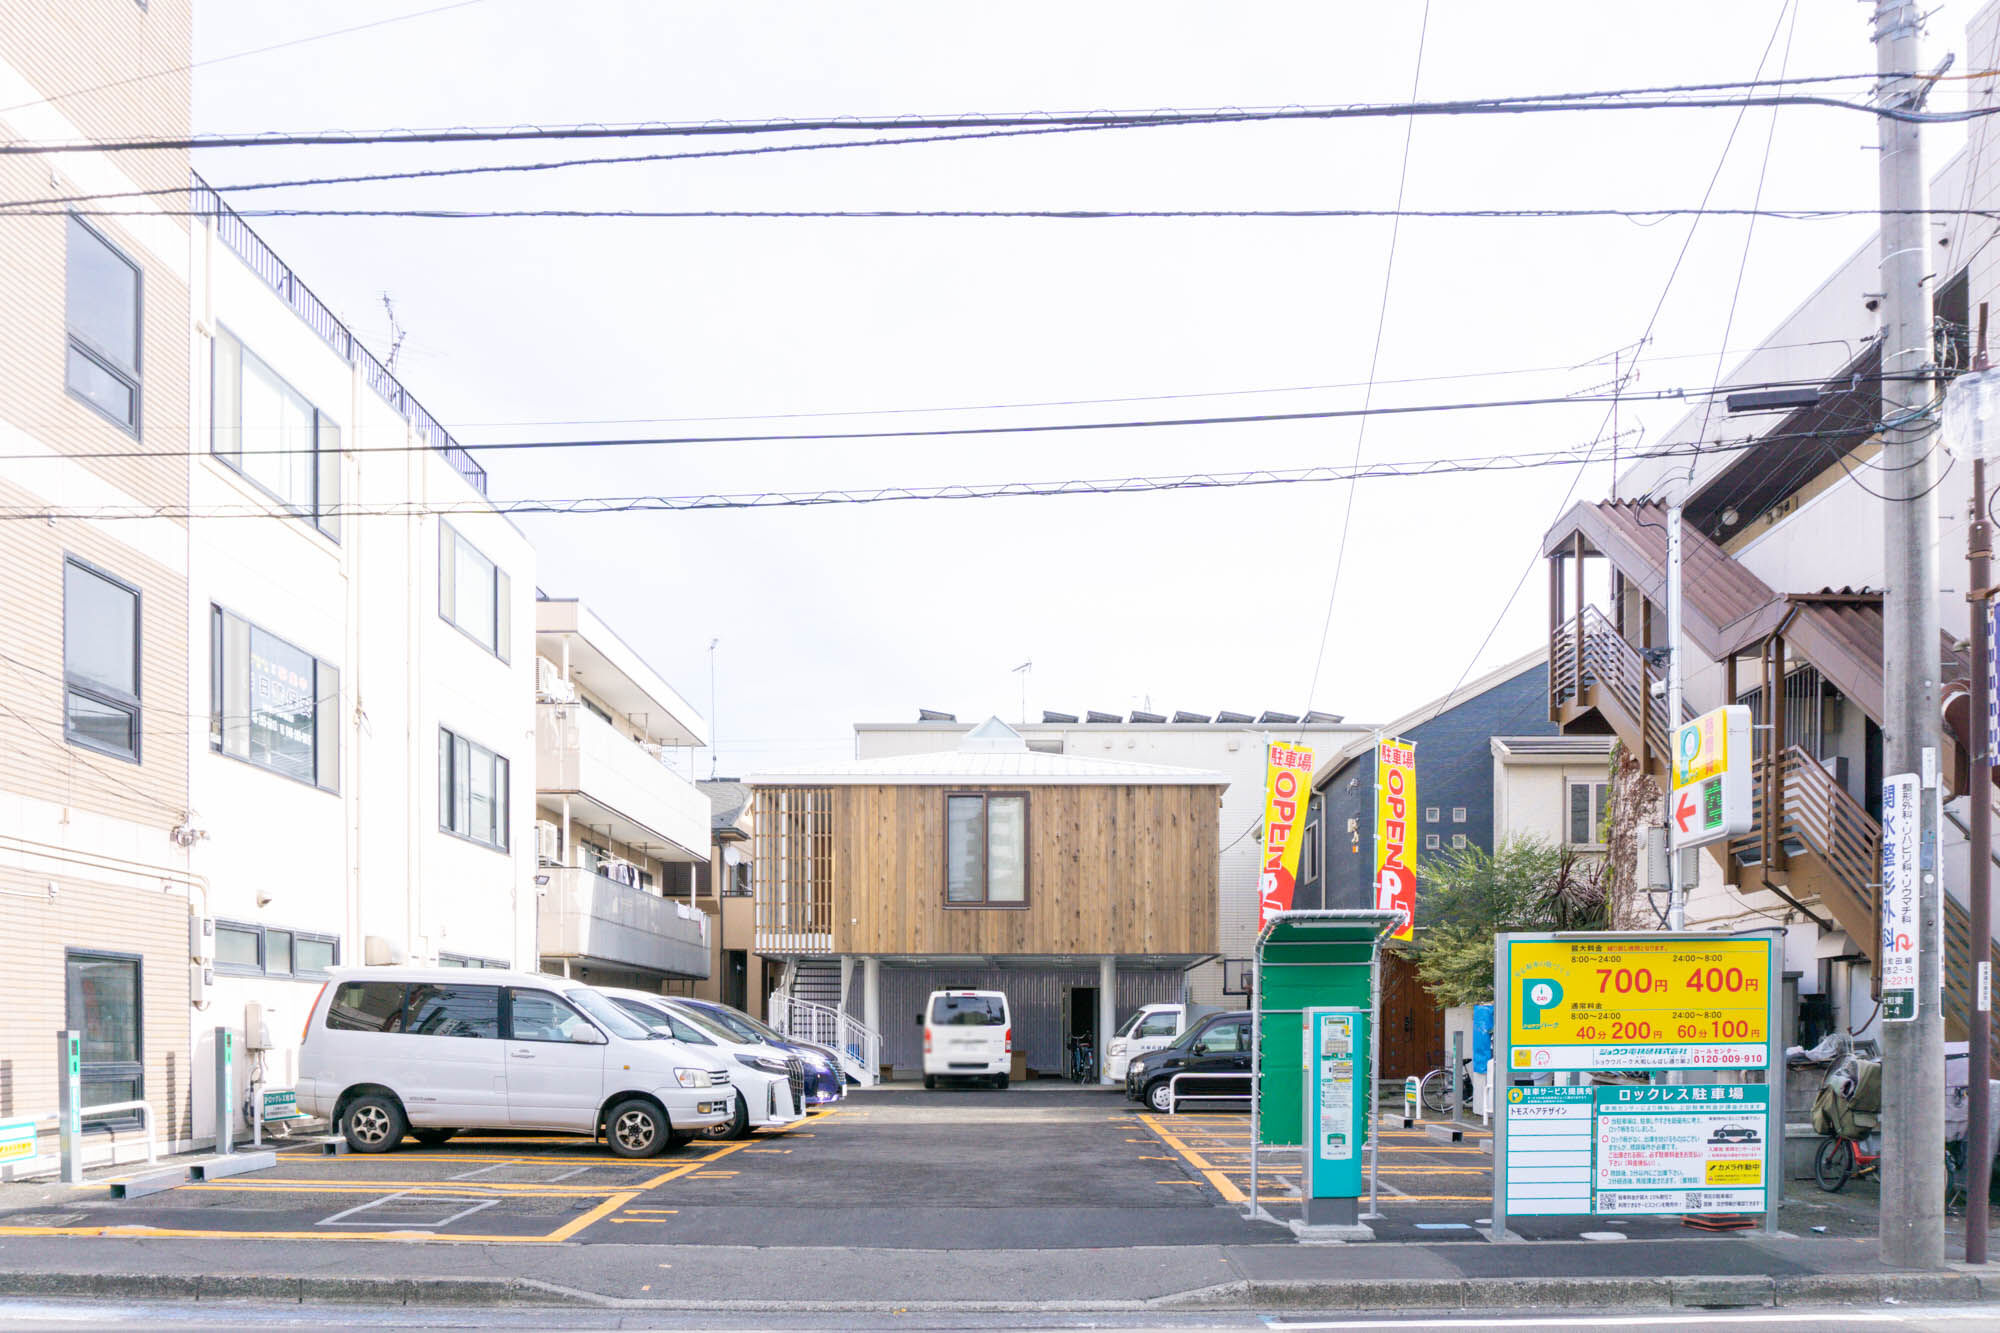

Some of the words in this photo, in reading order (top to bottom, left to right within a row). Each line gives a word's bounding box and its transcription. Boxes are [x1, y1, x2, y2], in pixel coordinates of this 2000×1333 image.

[1271, 745, 1312, 772] 駐車場
[1381, 744, 1414, 769] 駐車場
[1266, 771, 1298, 870] OPEN
[1385, 768, 1406, 870] OPEN
[1571, 945, 1603, 953] 最大料金
[1571, 1002, 1603, 1010] 通常料金
[1693, 1054, 1763, 1064] 0120-009-910
[1618, 1087, 1745, 1102] ロックレス駐車場
[1718, 1163, 1761, 1171] カメラ作動中
